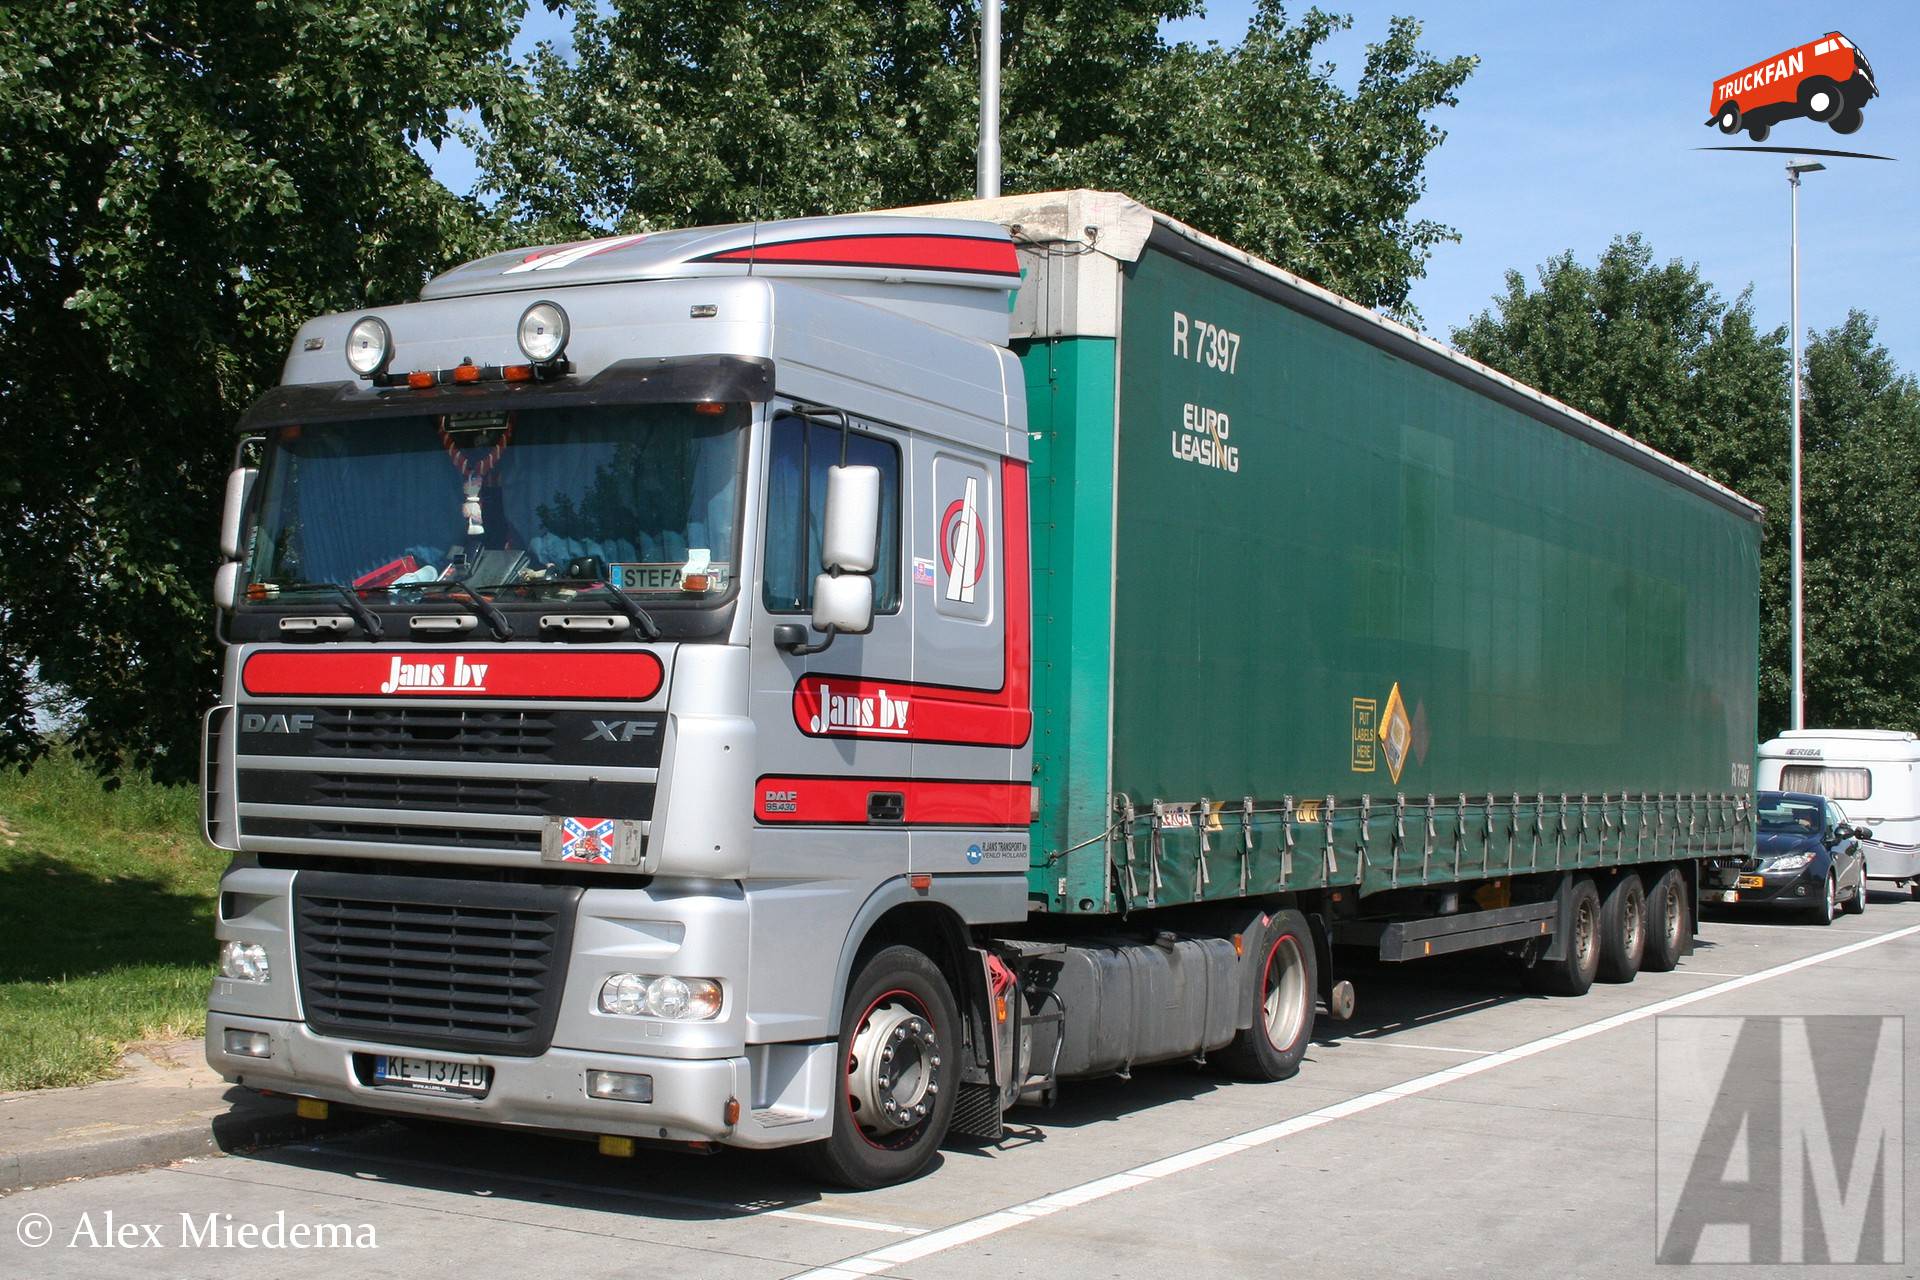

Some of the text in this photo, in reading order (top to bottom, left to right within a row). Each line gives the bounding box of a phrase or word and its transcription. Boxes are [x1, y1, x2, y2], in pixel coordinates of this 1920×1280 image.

[1173, 311, 1241, 375] R 7397
[1183, 402, 1229, 440] EURO
[1172, 431, 1239, 473] LEASING
[625, 568, 682, 587] STEFA
[381, 656, 488, 693] Jans bv
[811, 684, 909, 733] Jans bv
[1359, 711, 1370, 725] PUT
[242, 714, 314, 734] DAF
[581, 720, 658, 741] XF
[1354, 727, 1375, 741] LABELS
[1356, 744, 1372, 758] HERE
[1789, 748, 1821, 757] ERIBA
[765, 791, 797, 801] DAF
